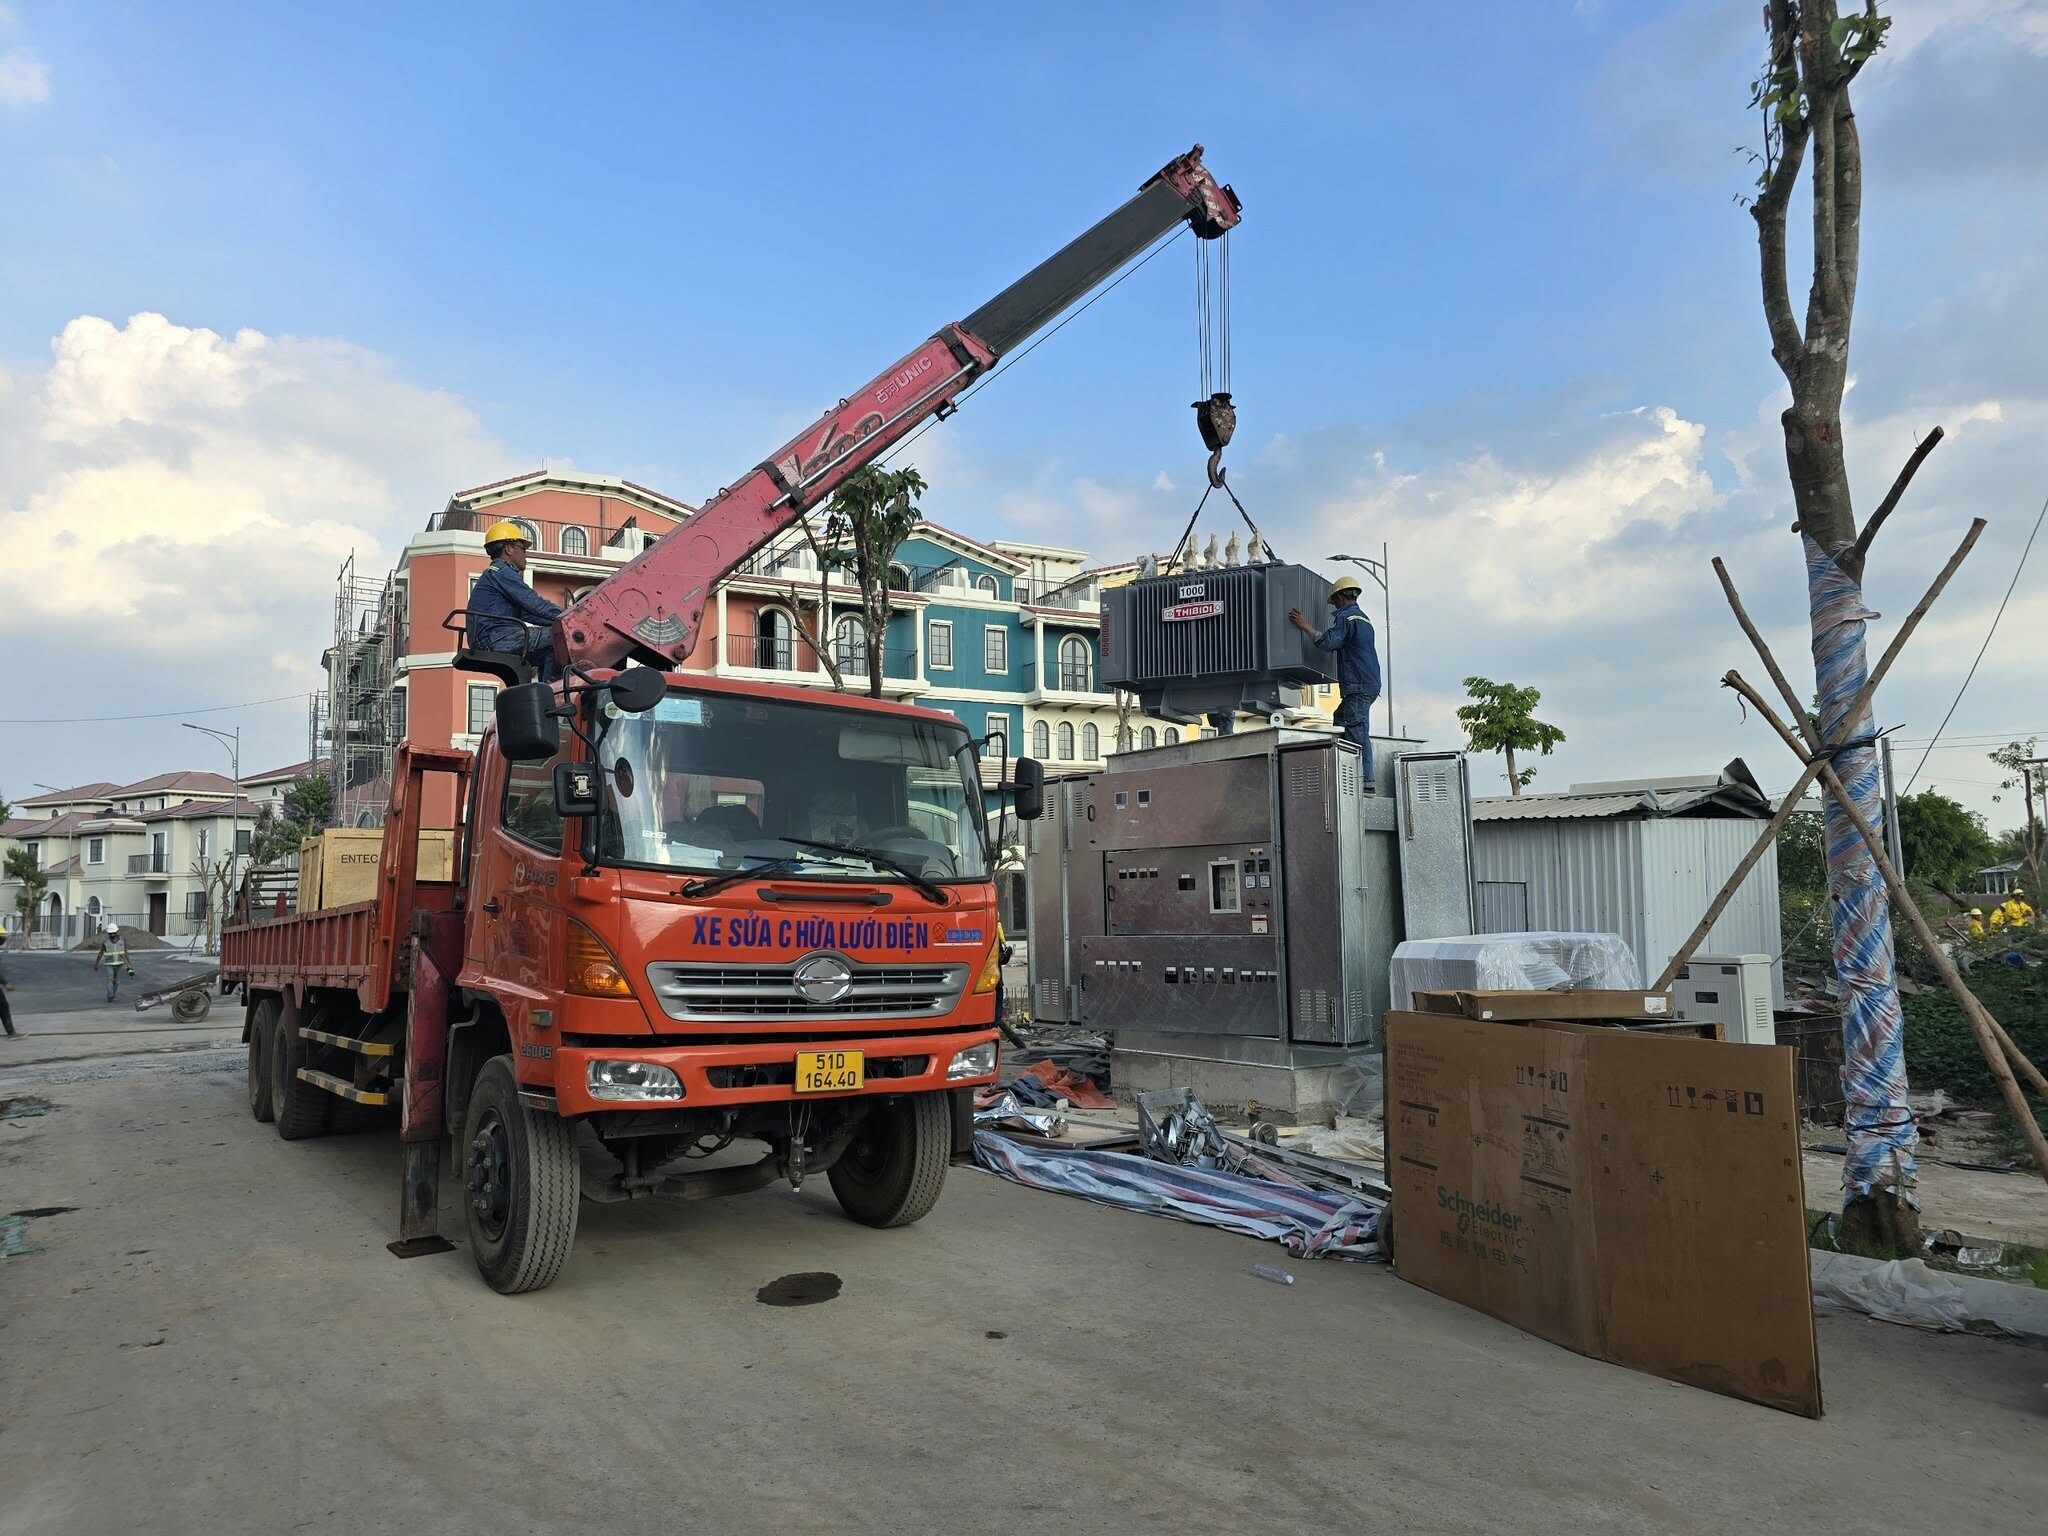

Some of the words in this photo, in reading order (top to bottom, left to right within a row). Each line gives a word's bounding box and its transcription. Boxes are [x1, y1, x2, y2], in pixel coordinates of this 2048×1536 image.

[896, 356, 932, 387] UNIC
[1181, 586, 1204, 597] 1000
[1175, 604, 1213, 617] THIBIDI
[341, 854, 379, 864] ENTEC
[692, 916, 722, 945] XE
[728, 908, 772, 947] SỬA
[840, 917, 882, 949] LƯỚI
[886, 916, 928, 954] ĐIỆN
[816, 1053, 845, 1070] 51D
[805, 1071, 856, 1088] 164.40
[1437, 1185, 1521, 1231] Schneider
[1472, 1220, 1526, 1249] Electric
